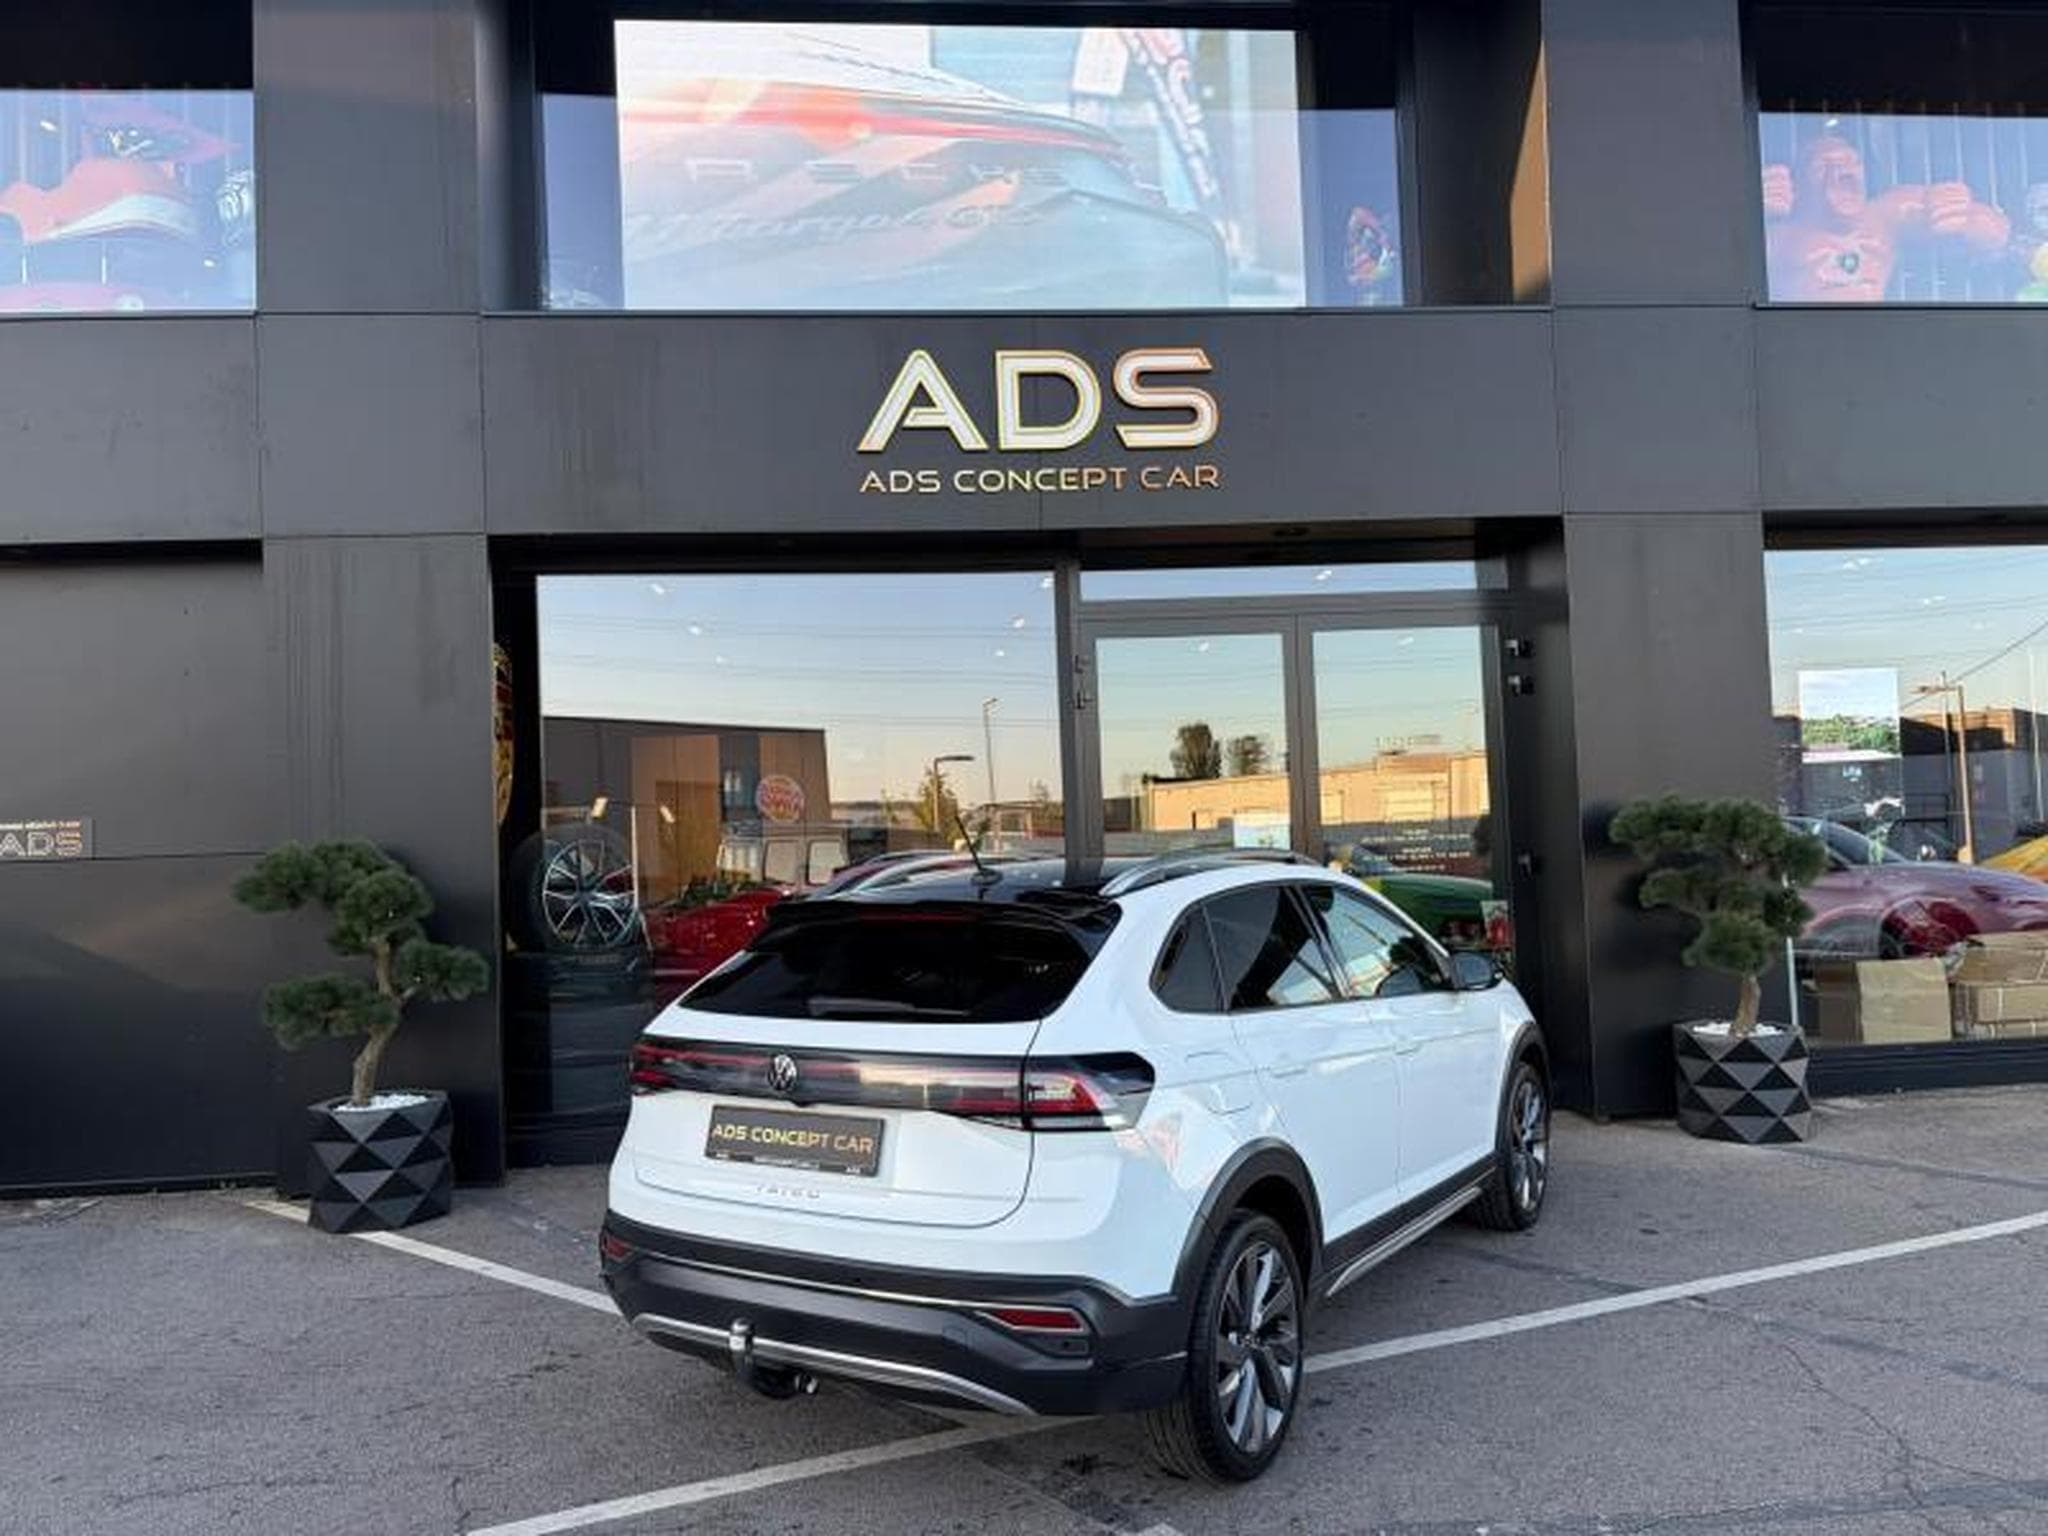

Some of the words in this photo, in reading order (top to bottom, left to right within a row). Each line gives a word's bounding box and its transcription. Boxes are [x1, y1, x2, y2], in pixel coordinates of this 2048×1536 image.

[857, 348, 1221, 453] ADS
[859, 469, 941, 494] ADS
[953, 466, 1129, 493] CONCEPT
[1139, 464, 1221, 490] CAR
[711, 1123, 747, 1141] ADS
[750, 1126, 831, 1149] CONCEPT
[833, 1135, 874, 1155] CAR
